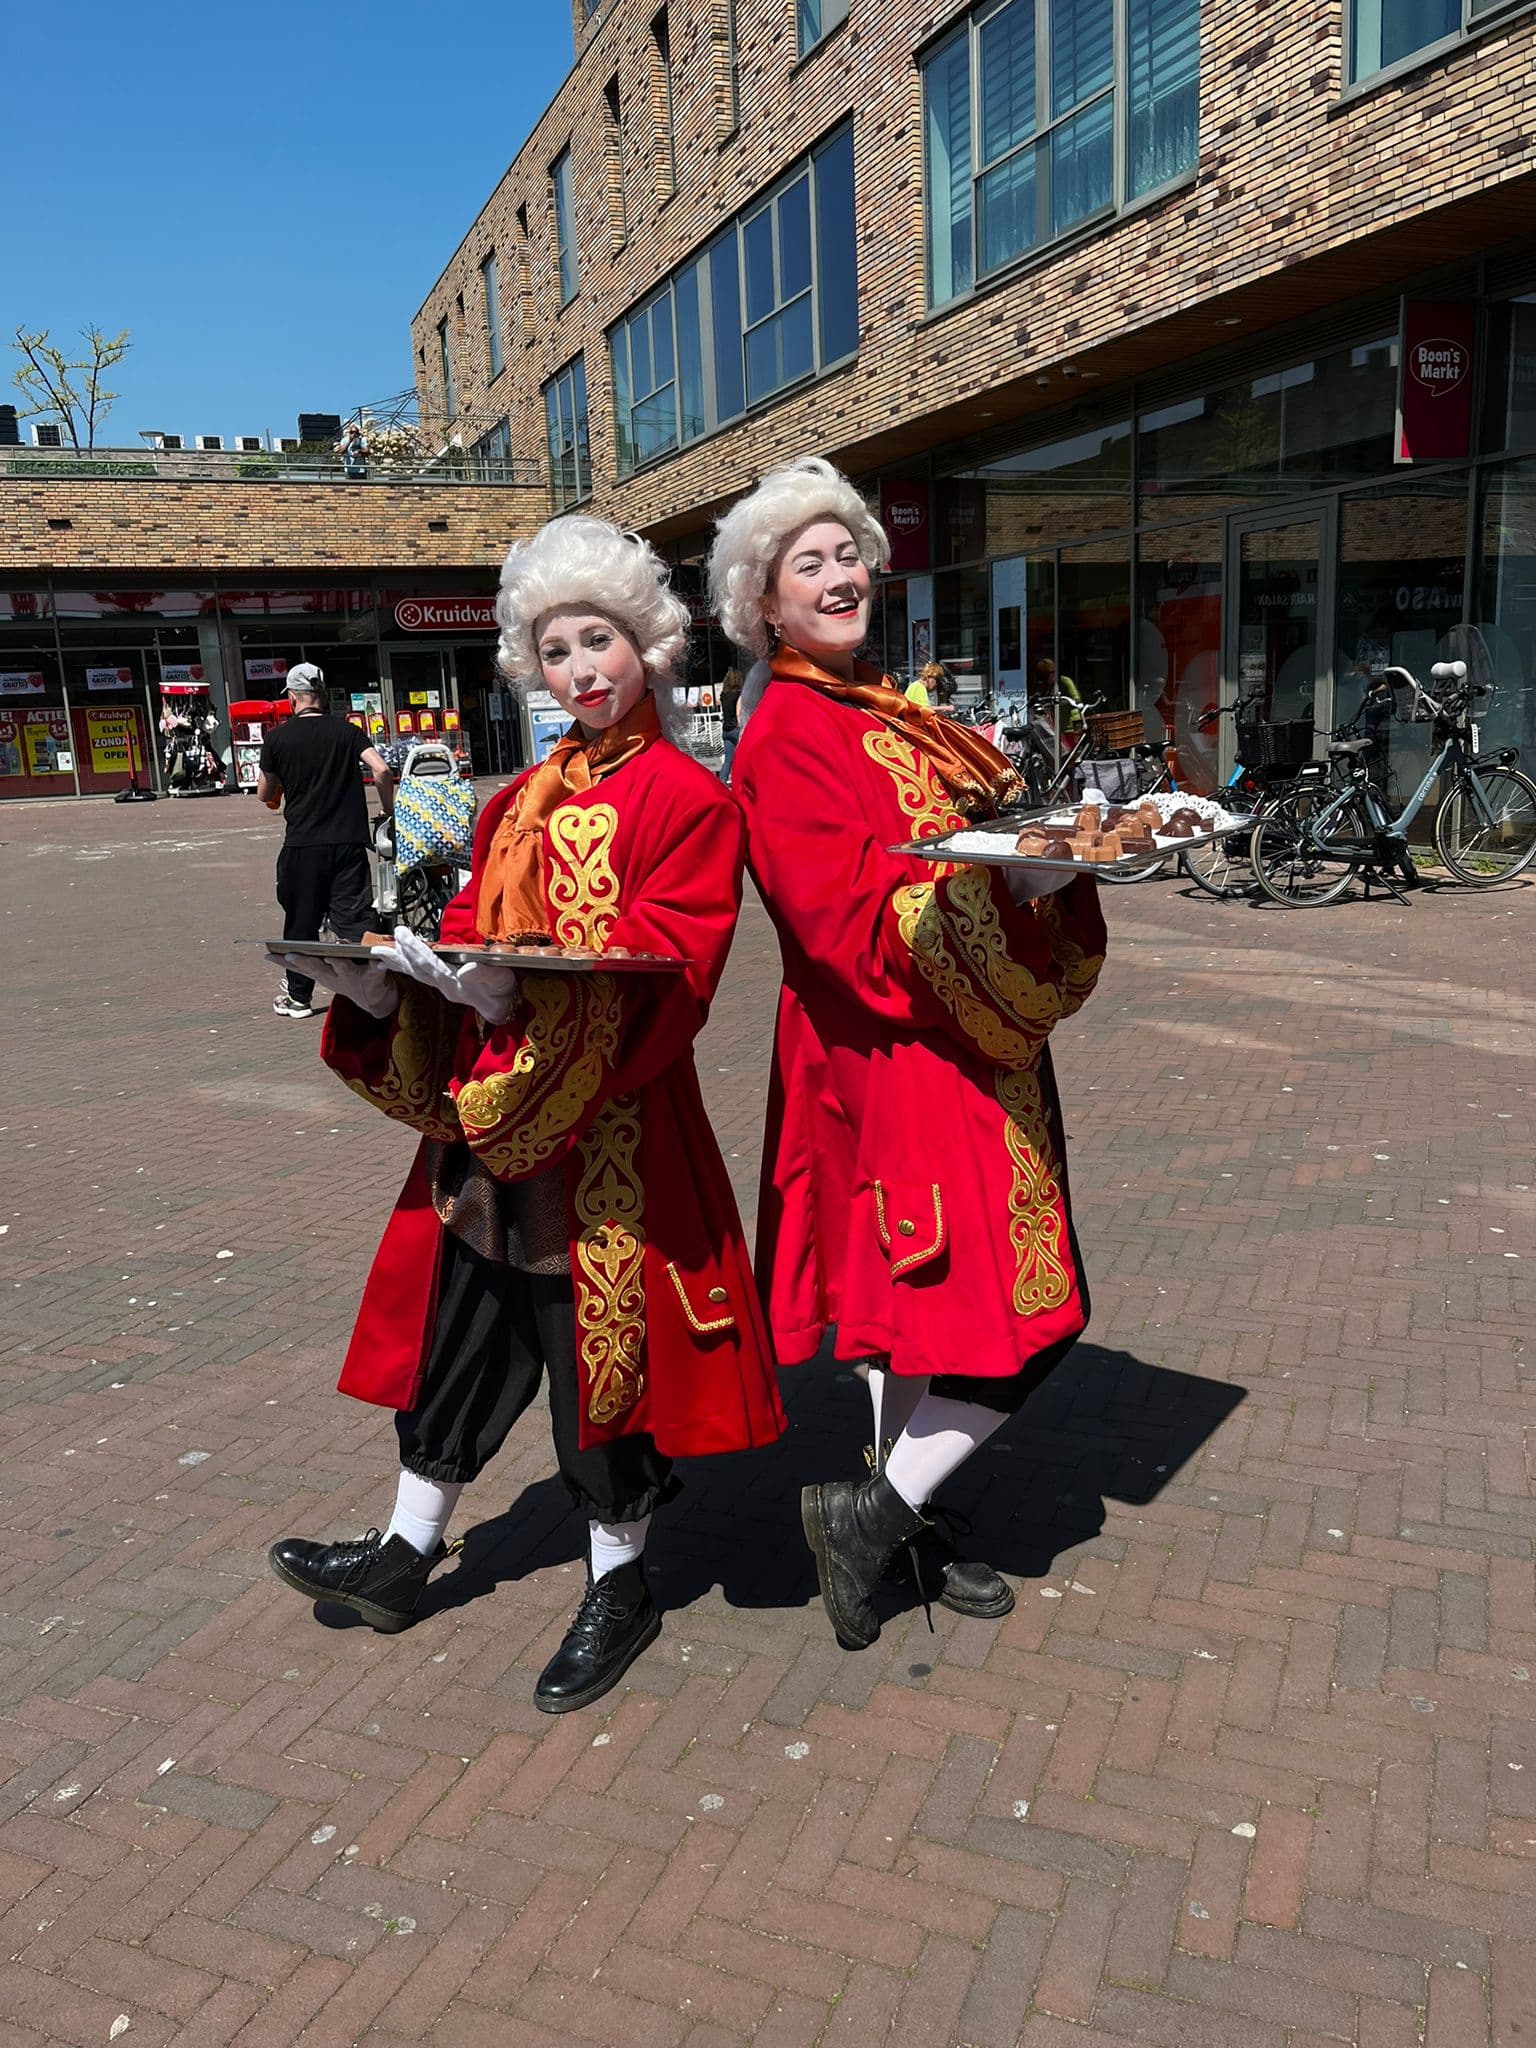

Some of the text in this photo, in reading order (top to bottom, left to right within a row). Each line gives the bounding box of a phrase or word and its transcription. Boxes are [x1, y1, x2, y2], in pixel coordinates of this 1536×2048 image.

[1418, 347, 1460, 363] Boon's
[1420, 363, 1460, 379] Markt
[891, 506, 919, 516] Boon's
[893, 515, 919, 525] Markt
[423, 605, 497, 623] Kruidvat
[99, 711, 131, 720] Kruidvat
[102, 725, 124, 734] ELKE
[104, 750, 129, 760] OPEN
